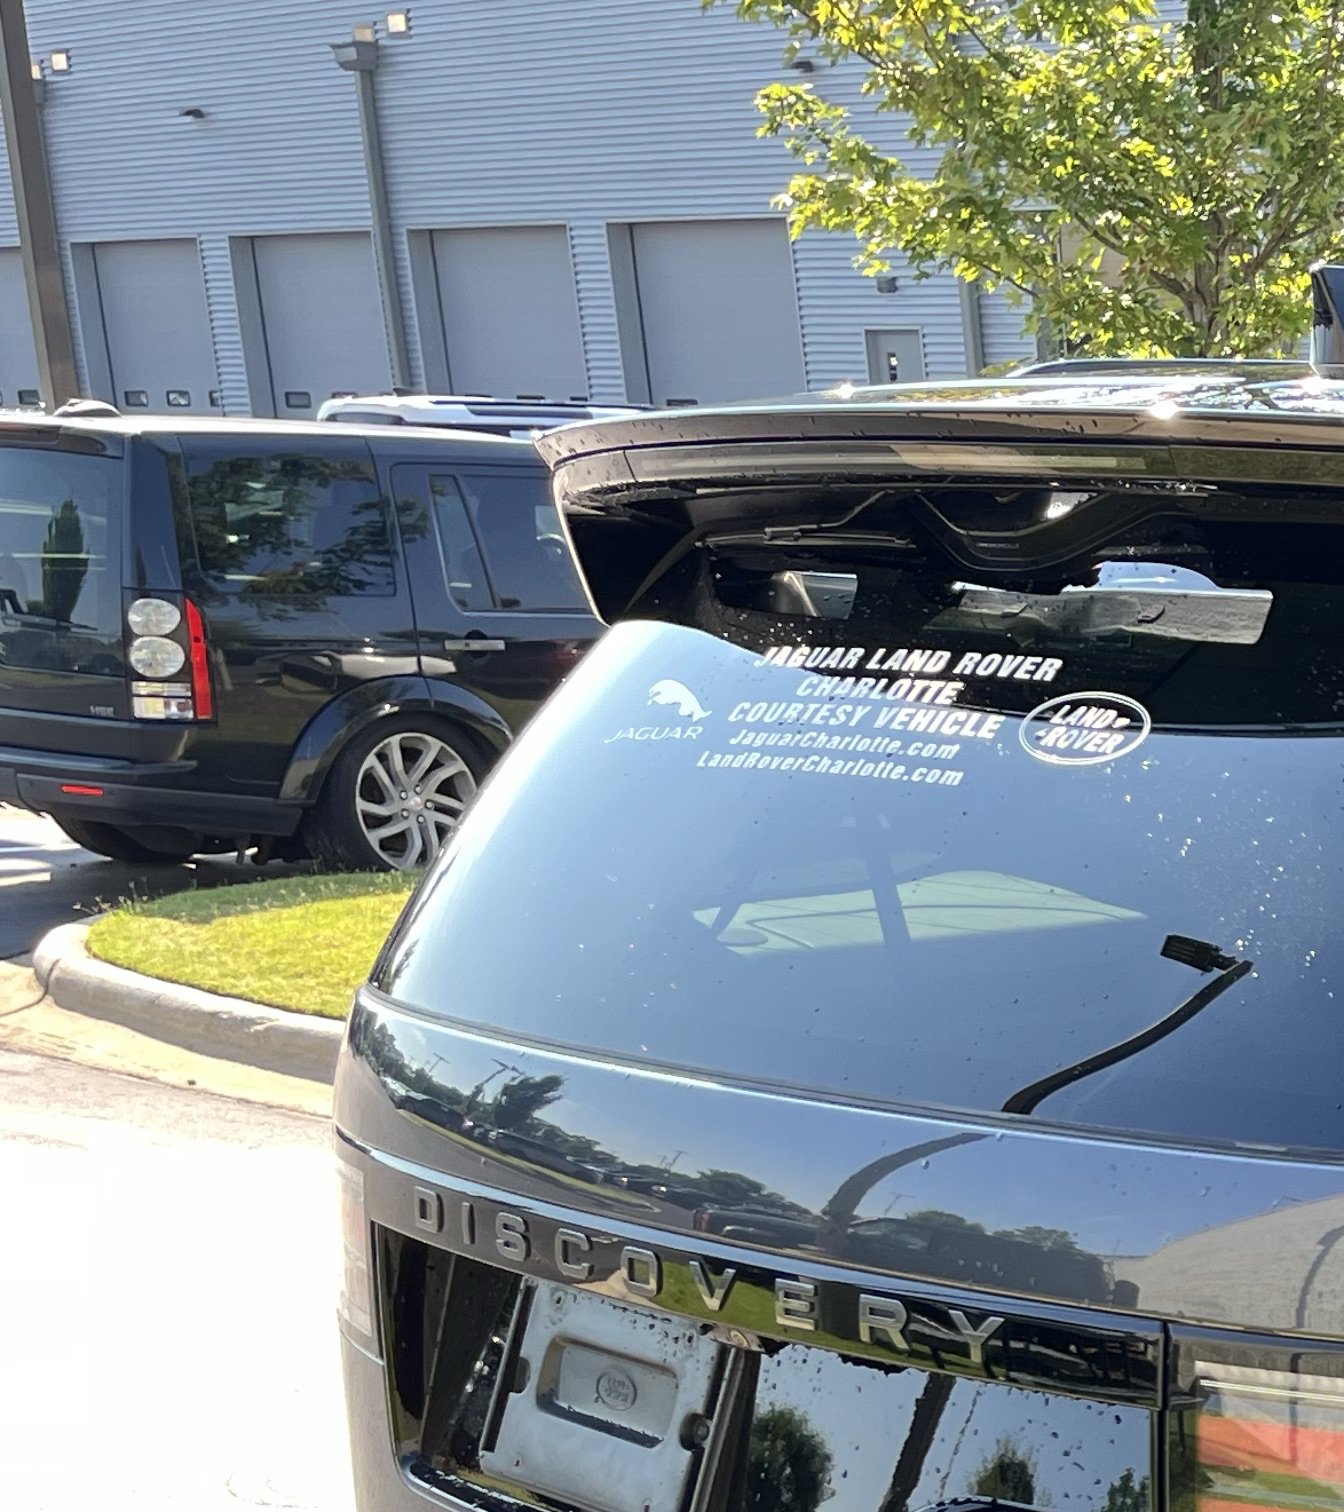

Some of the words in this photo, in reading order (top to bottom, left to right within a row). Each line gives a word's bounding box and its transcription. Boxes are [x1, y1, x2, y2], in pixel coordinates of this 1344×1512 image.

[753, 645, 865, 669] JAGUAR
[865, 648, 951, 673] LAND
[952, 652, 1063, 681] ROVER
[796, 676, 966, 704] CHARLOTTE
[728, 702, 872, 728] COURTESY
[873, 707, 1006, 739] VEHICLE
[1050, 704, 1117, 728] LAND
[604, 726, 703, 743] JAGUAR
[729, 729, 962, 760] JaguarCharlotte.com
[1040, 726, 1124, 753] ROVER
[697, 750, 965, 786] LandRoverCharlotte.com
[413, 1184, 1004, 1364] DISCOVERY
